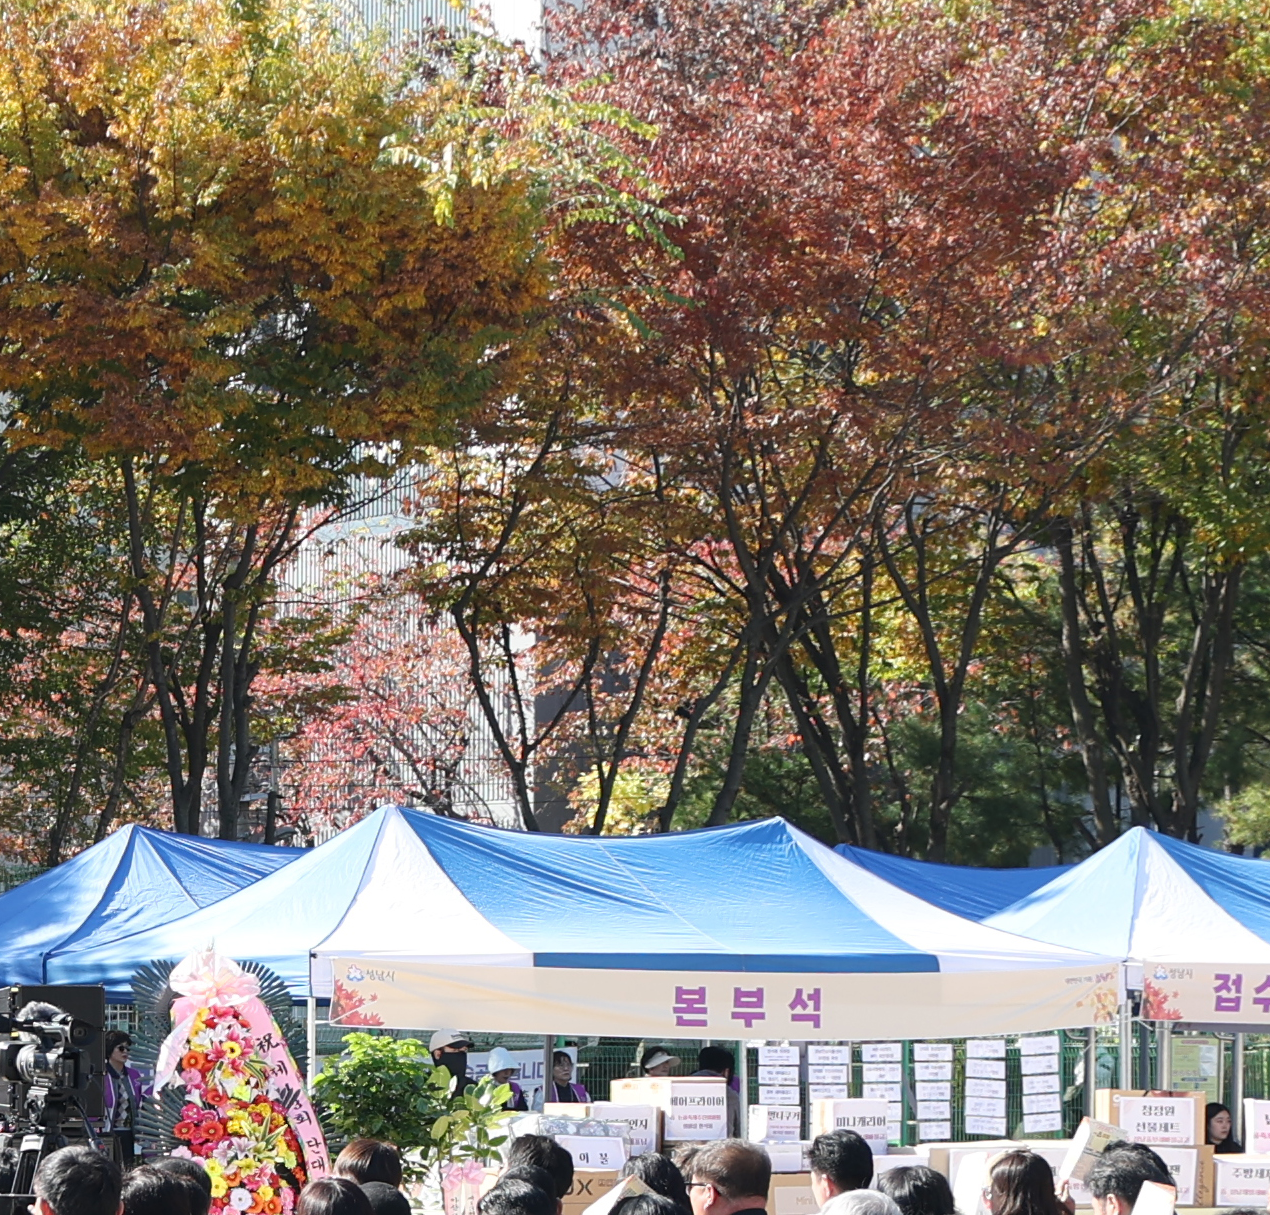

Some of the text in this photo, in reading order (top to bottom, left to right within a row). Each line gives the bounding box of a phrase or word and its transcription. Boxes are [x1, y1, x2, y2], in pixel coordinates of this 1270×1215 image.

[366, 968, 395, 982] 성남시
[1168, 967, 1194, 980] 성남시
[1142, 1105, 1175, 1116] 청정원
[1136, 1122, 1181, 1133] 선물세트
